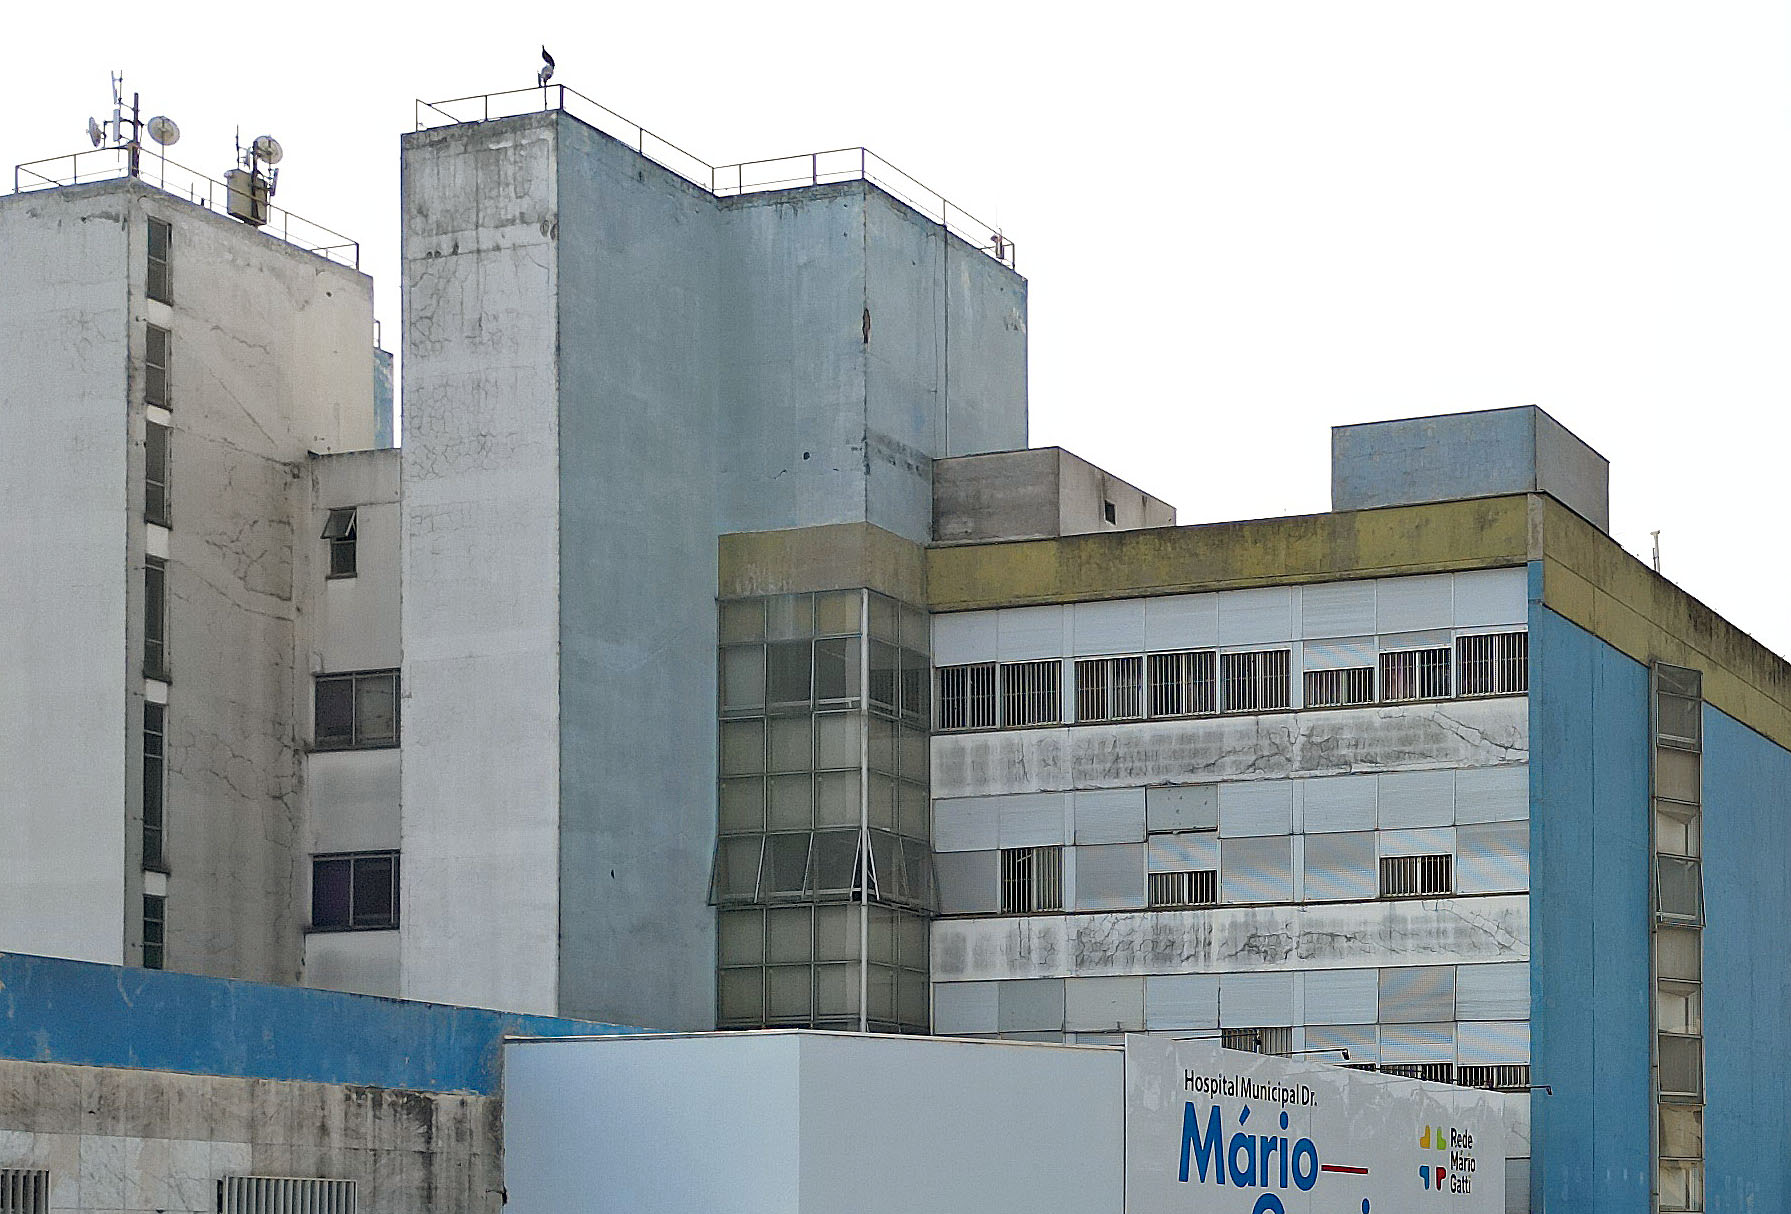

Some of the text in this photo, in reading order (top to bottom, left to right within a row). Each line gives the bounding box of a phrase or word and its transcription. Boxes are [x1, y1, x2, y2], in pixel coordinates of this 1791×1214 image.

[1184, 1069, 1318, 1108] Hospital Municipal Dr.
[1178, 1101, 1319, 1192] Mário
[1450, 1127, 1473, 1150] Rede
[1450, 1149, 1476, 1173] Mário
[1450, 1173, 1471, 1194] Gatti
